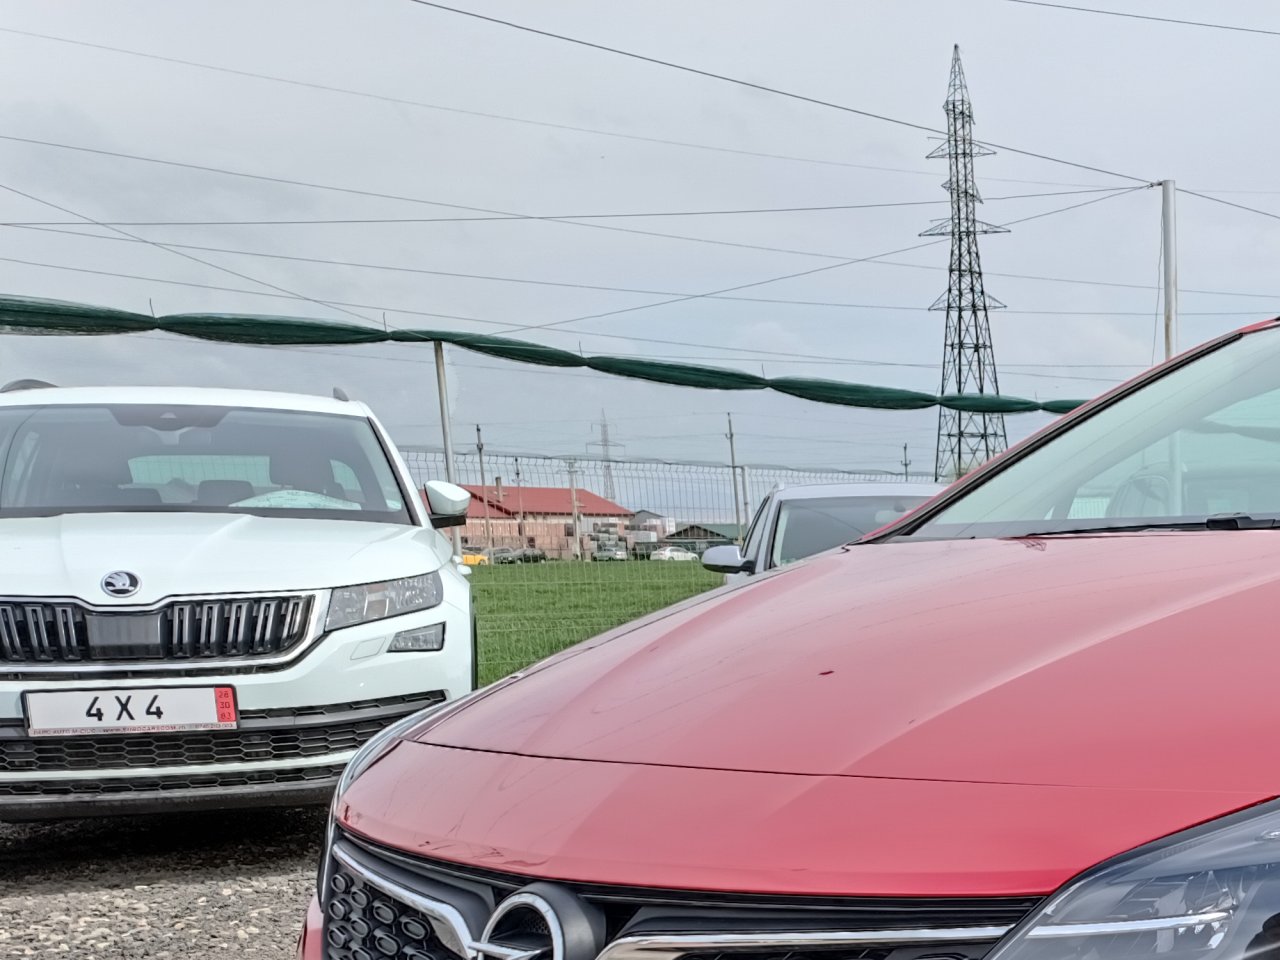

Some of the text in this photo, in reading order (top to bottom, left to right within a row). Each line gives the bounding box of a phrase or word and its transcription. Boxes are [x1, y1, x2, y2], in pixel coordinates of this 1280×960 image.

[86, 694, 163, 721] 4 X 4
[219, 701, 230, 709] 30
